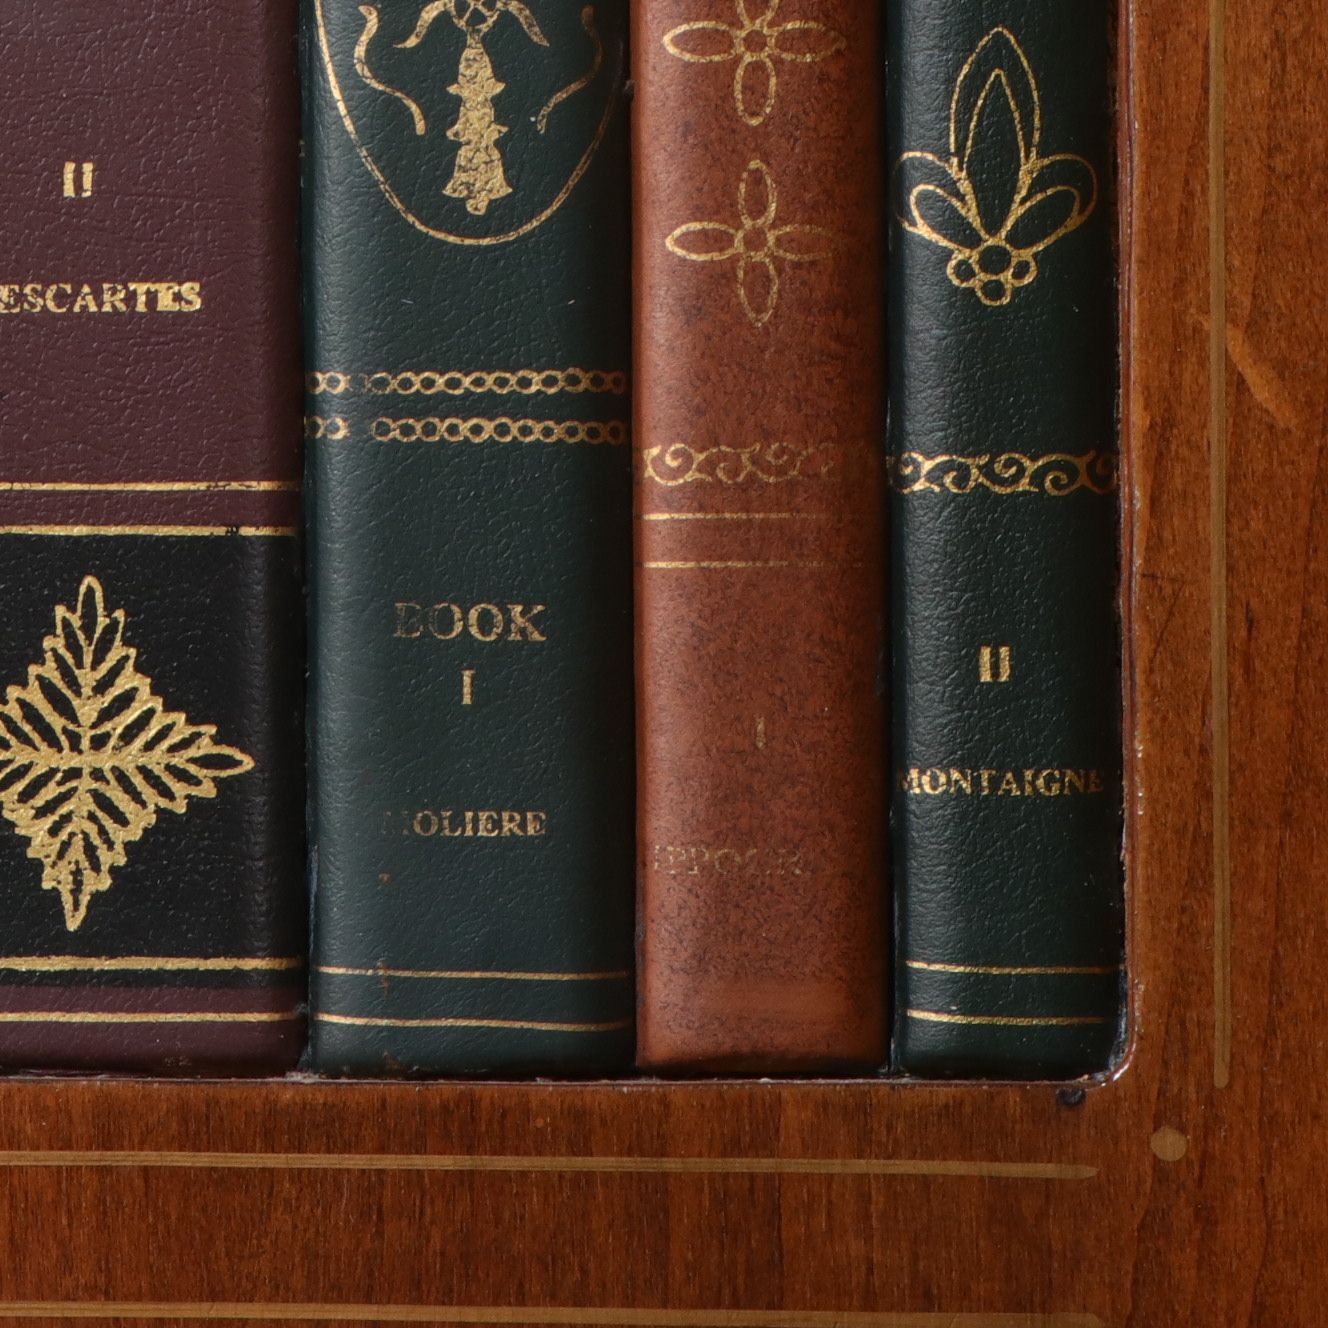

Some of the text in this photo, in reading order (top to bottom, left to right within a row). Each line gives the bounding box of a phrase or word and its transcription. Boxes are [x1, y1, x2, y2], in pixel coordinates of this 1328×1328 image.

[63, 162, 93, 198] II
[393, 603, 547, 641] BOOK
[979, 646, 1011, 682] II
[461, 669, 475, 704] I
[383, 810, 547, 837] OLIERE
